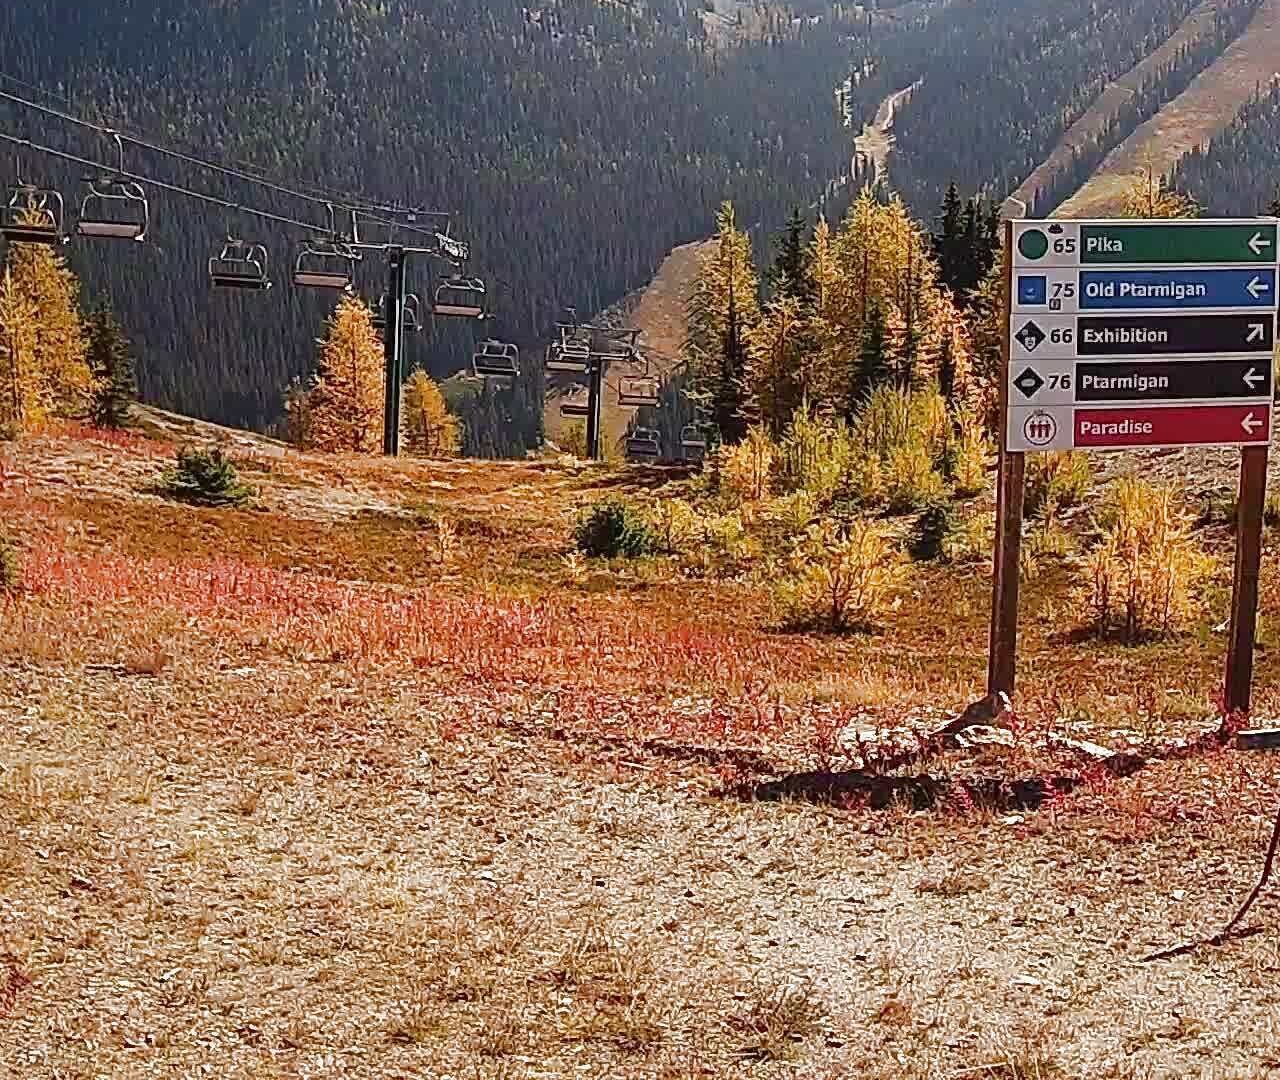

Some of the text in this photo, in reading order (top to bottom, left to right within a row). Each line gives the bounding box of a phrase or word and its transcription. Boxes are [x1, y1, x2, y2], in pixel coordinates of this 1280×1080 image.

[1053, 237, 1123, 253] 65 Pika
[1051, 281, 1206, 301] 75 Old Ptarmigan
[1050, 327, 1168, 343] 66 Exhibition
[1048, 373, 1169, 392] 76 Ptarmigan
[1080, 419, 1153, 435] Paradise
